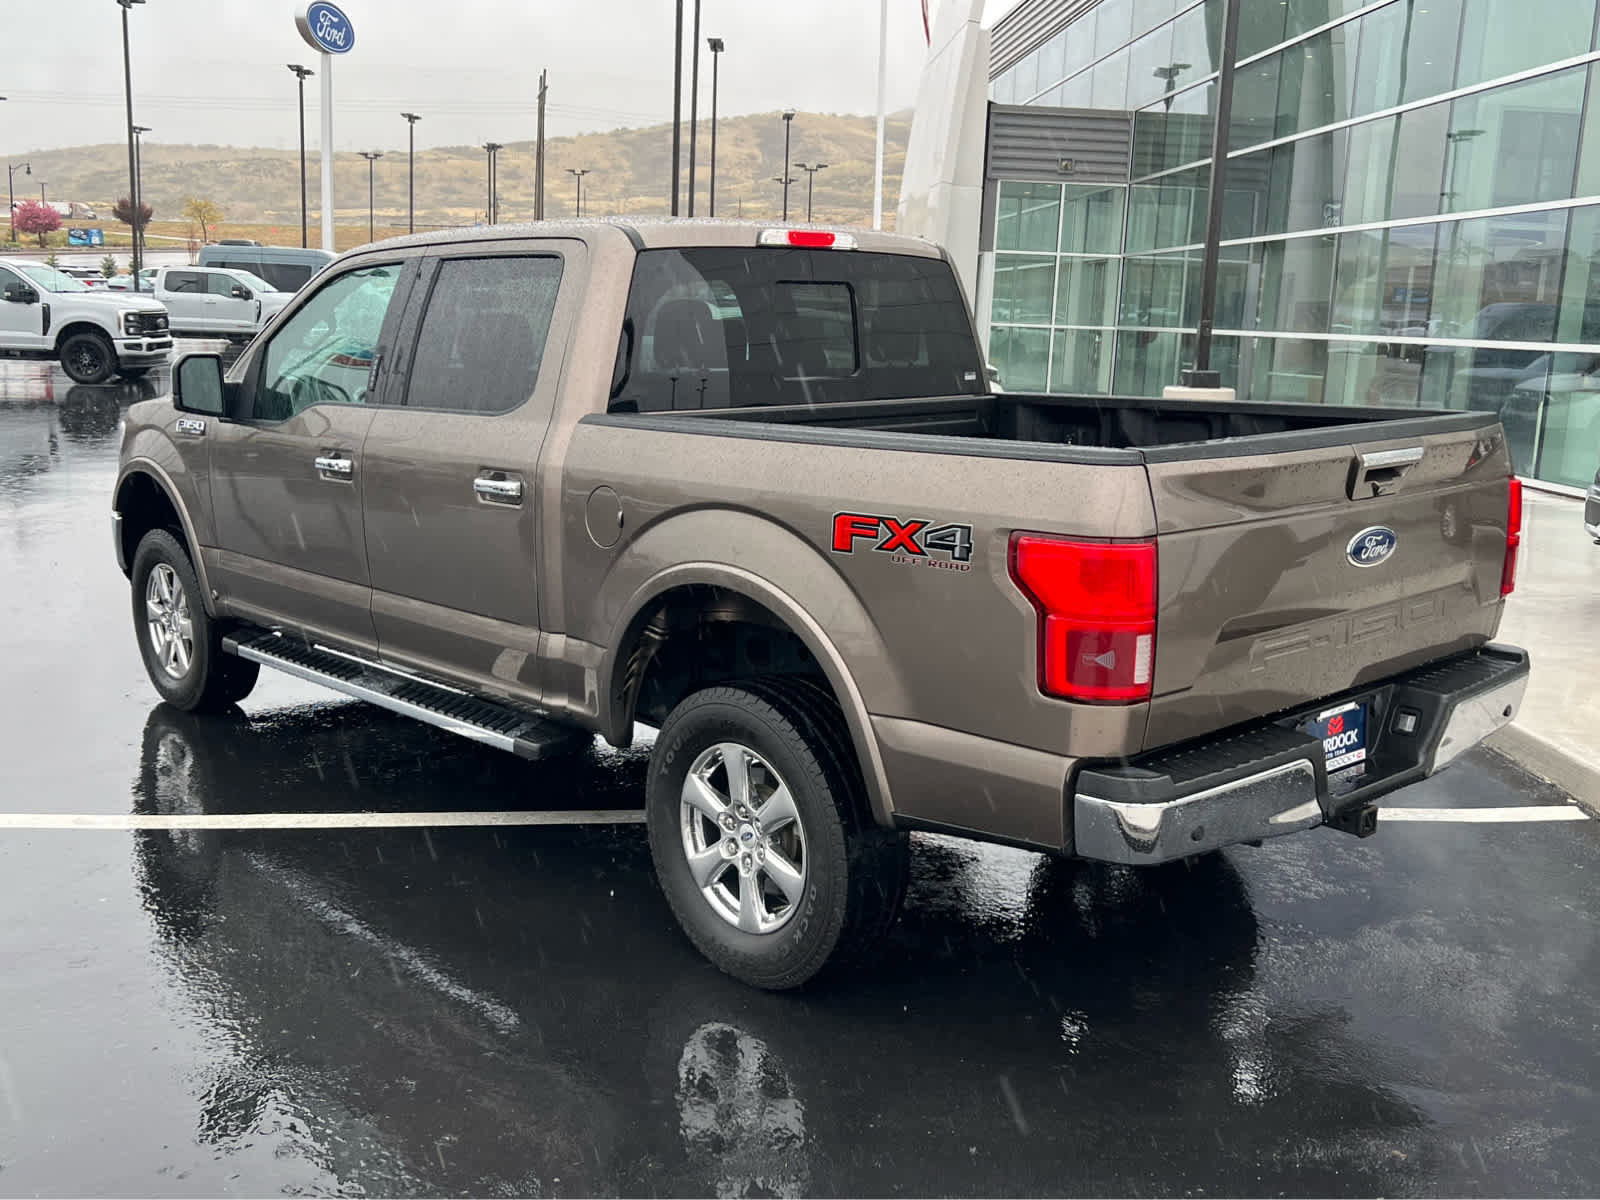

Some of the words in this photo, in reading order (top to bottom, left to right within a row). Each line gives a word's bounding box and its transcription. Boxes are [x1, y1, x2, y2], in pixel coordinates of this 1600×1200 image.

[316, 10, 346, 46] Ford
[831, 510, 974, 563] FX4
[1361, 535, 1390, 559] Ford
[891, 555, 922, 565] OFF
[928, 559, 971, 572] ROAD
